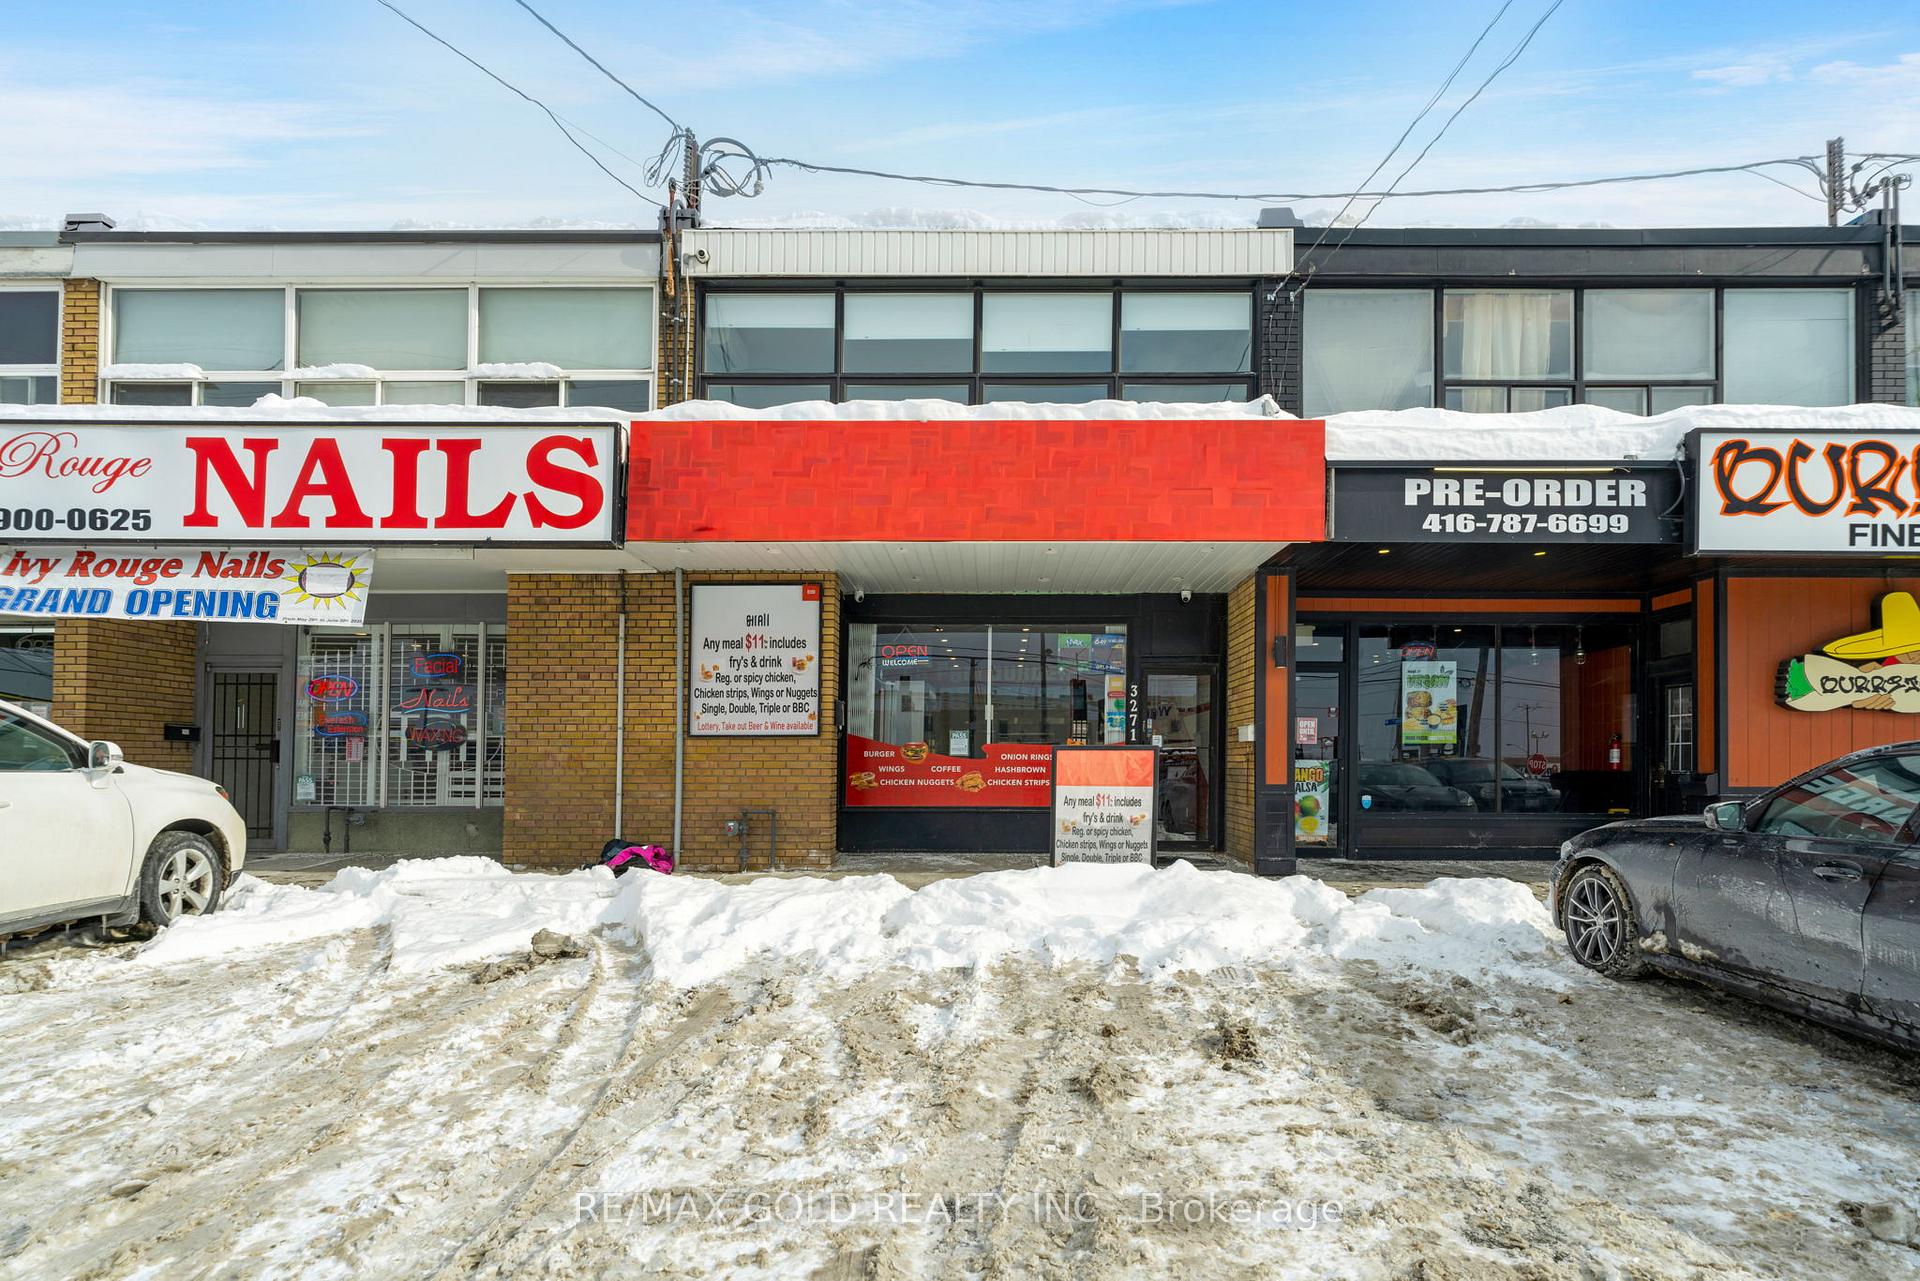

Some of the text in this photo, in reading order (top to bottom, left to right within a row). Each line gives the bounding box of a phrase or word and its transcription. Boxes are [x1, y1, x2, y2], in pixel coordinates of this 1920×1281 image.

[0, 431, 152, 493] Rouge
[183, 434, 605, 530] NAILS
[1404, 478, 1647, 507] PRE-ORDER
[1422, 513, 1629, 534] 416-787-6699
[1, 550, 286, 585] Ivy Rouge Nails
[0, 585, 281, 620] GRAND OPENING
[703, 637, 720, 652] Any
[722, 637, 743, 649] meal
[769, 636, 807, 649] includes
[881, 645, 929, 659] OPEN
[1401, 646, 1435, 657] OPEN
[414, 657, 459, 673] Facial
[729, 655, 782, 671] fry's & drink
[715, 672, 796, 685] Reg. or spicy chicken,
[400, 686, 470, 708] Nails
[694, 687, 818, 700] Chicken strips, Wings or Nuggets
[701, 703, 727, 716] Single,
[729, 702, 757, 715] Double,
[759, 702, 781, 715] Triple
[782, 705, 790, 713] or
[1129, 684, 1138, 741] 3271
[721, 721, 736, 731] Take
[738, 722, 747, 731] out
[748, 721, 763, 731] Beer
[764, 721, 769, 730] &
[770, 721, 785, 730] Wine
[786, 720, 814, 730] available
[1299, 720, 1315, 728] OPEN
[863, 750, 895, 758] BURGER
[1000, 753, 1028, 761] ONION
[878, 765, 905, 773] WINGS
[930, 765, 961, 773] COFFEE
[994, 766, 1046, 774] HASHBROWN
[1295, 767, 1325, 782] ANGO
[880, 778, 954, 786] CHICKEN NUGGETS
[987, 778, 1050, 786] CHICKEN STRIPS
[1295, 782, 1318, 793] ALSA
[1063, 795, 1076, 808] Any
[1078, 795, 1094, 806] meal
[1114, 795, 1142, 807] includes
[1083, 812, 1123, 825] fry's & drink
[1086, 828, 1093, 836] or
[1094, 827, 1109, 838] spicy
[1056, 840, 1078, 849] Chicken
[1099, 840, 1117, 851] Wings
[1118, 841, 1124, 849] or
[1125, 840, 1148, 851] Nuggets
[1105, 852, 1121, 862] Triple
[1122, 854, 1129, 862] or
